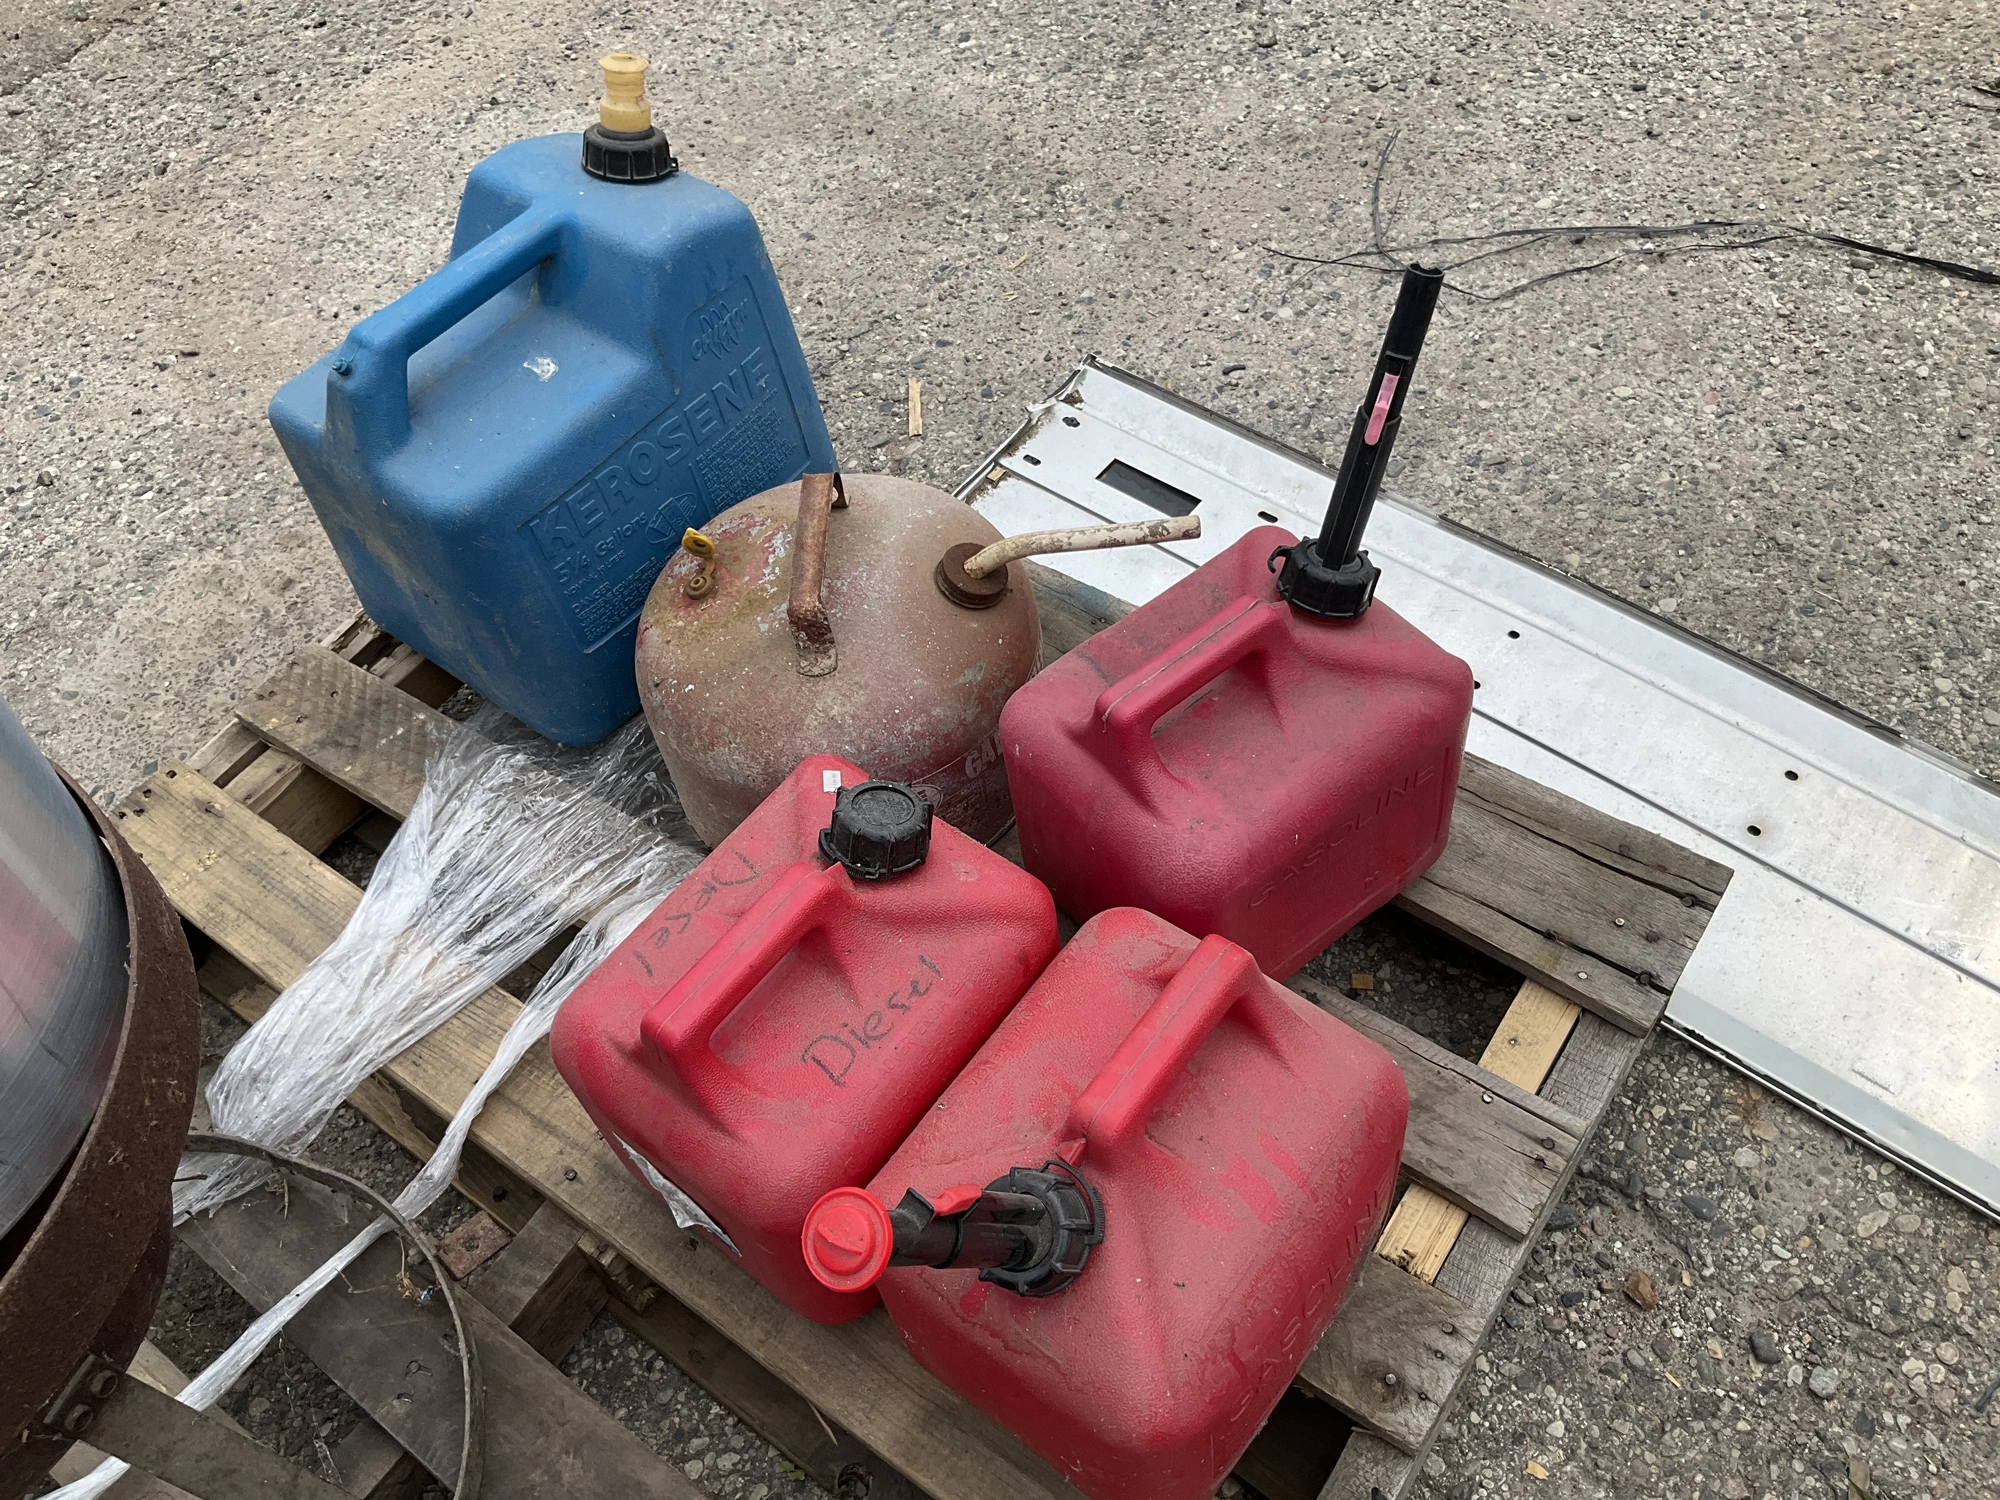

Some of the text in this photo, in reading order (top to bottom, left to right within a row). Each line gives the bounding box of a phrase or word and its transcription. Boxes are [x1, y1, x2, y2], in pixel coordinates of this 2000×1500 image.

[528, 346, 777, 563] KEROSENE
[562, 569, 598, 599] NOMINAL
[603, 548, 627, 568] LITERS
[593, 509, 650, 559] Gallons
[570, 579, 613, 614] DANGER
[575, 590, 615, 622] KEROSENE
[611, 555, 657, 596] COMBUSTIBLE
[1247, 765, 1434, 907] GASOLINE
[802, 955, 943, 1087] Diesel
[877, 995, 950, 1079] ADVERTENCIA
[966, 1007, 1036, 1088] ADVERTENCIA
[1231, 1166, 1393, 1422] GASOLINE
